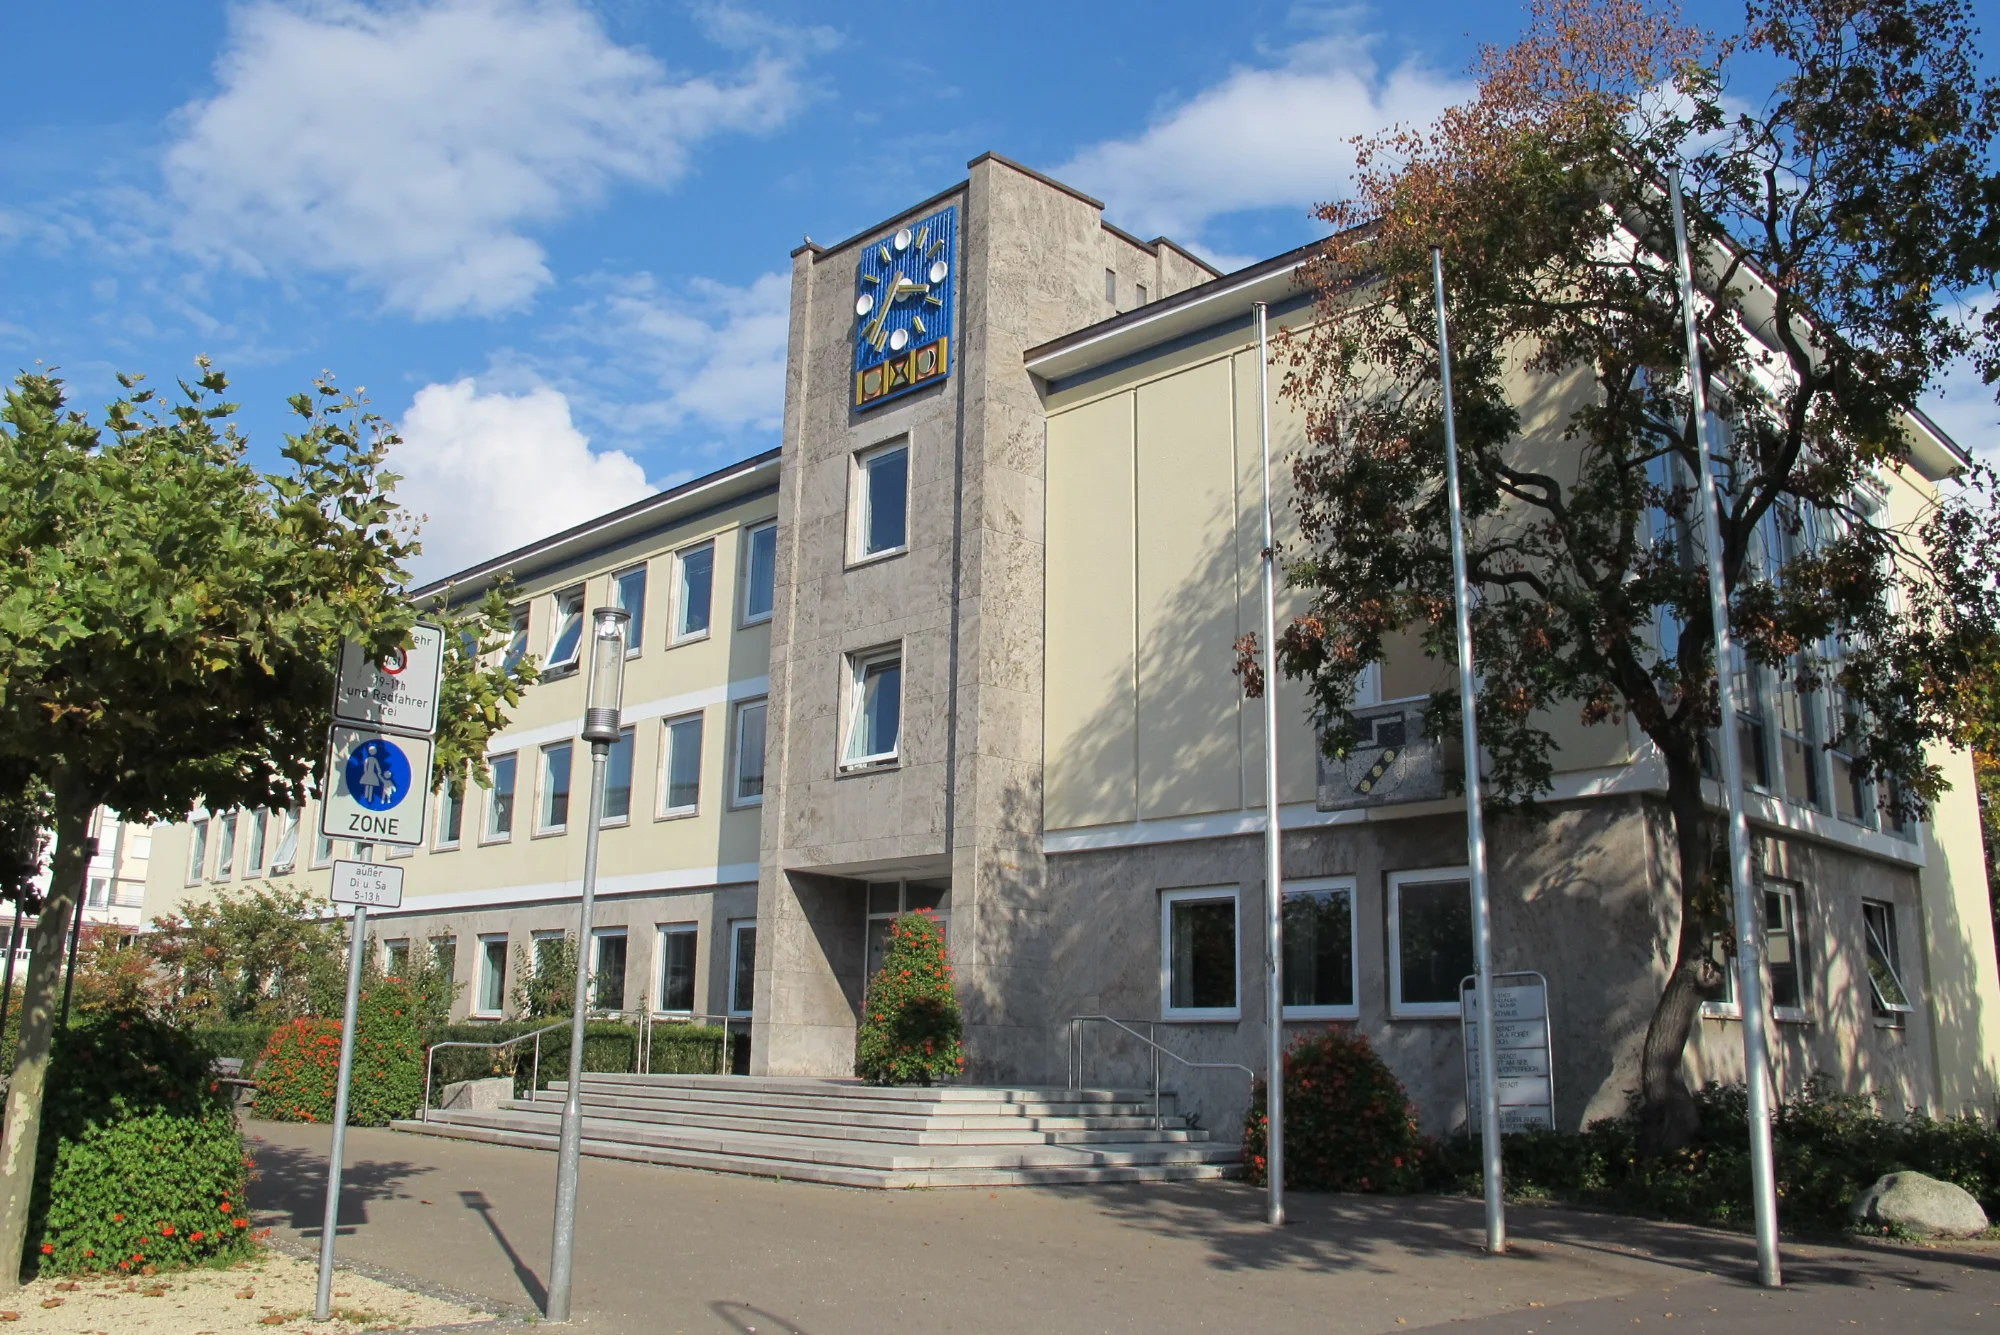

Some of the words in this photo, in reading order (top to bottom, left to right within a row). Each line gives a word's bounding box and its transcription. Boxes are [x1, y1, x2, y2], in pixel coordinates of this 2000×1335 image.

[347, 687, 368, 698] und
[372, 689, 428, 708] Radfahrer
[378, 704, 397, 716] frei
[349, 813, 399, 835] ZONE
[356, 867, 383, 877] außer
[350, 877, 359, 887] Di
[375, 880, 386, 890] Sa
